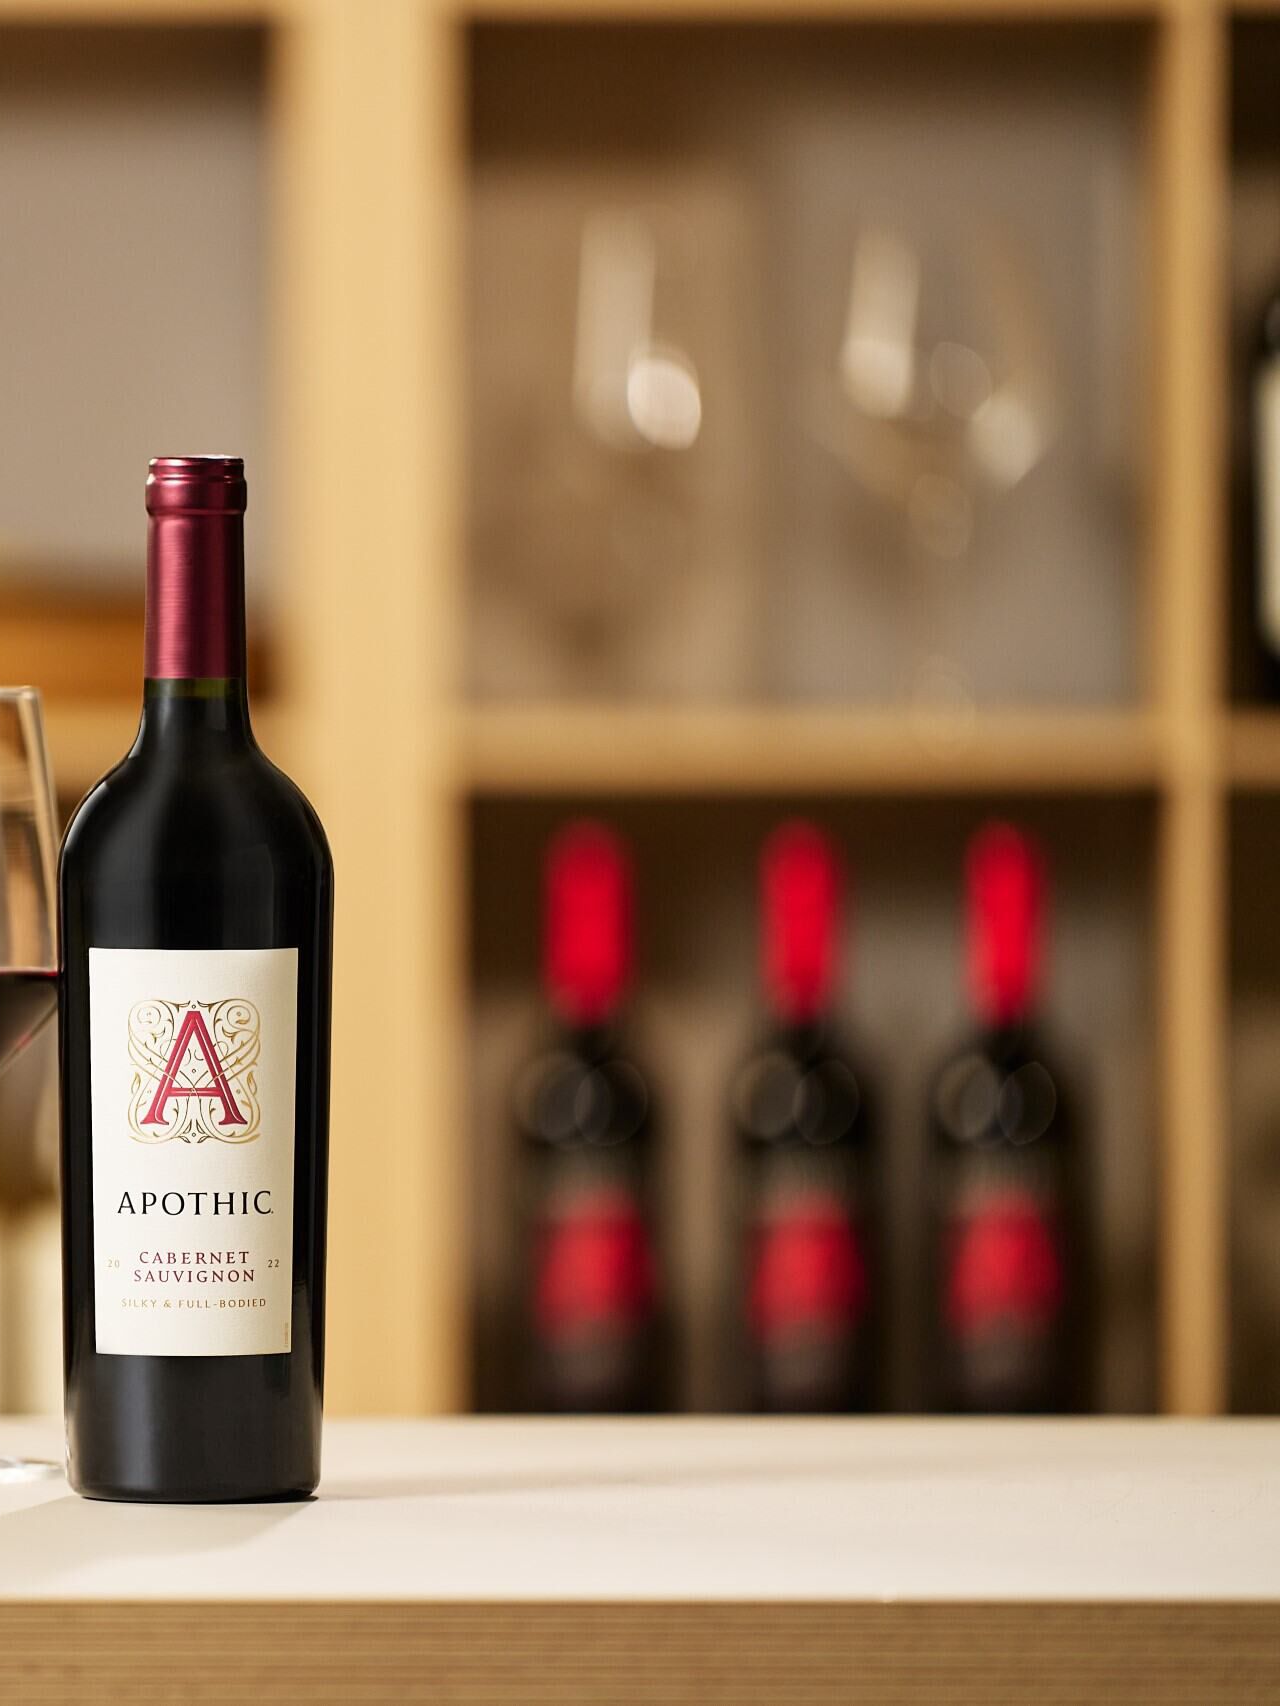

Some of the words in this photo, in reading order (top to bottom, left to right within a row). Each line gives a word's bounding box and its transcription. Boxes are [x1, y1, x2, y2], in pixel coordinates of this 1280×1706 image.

[140, 1010, 248, 1125] A
[117, 1190, 272, 1216] APOTHIC
[108, 1259, 120, 1268] 20
[139, 1251, 250, 1265] CABERNET
[267, 1259, 280, 1268] 22
[133, 1269, 255, 1283] SAUVIGNON
[121, 1298, 157, 1308] SILKY
[163, 1299, 172, 1308] &
[178, 1298, 266, 1309] FULL-BODIED
